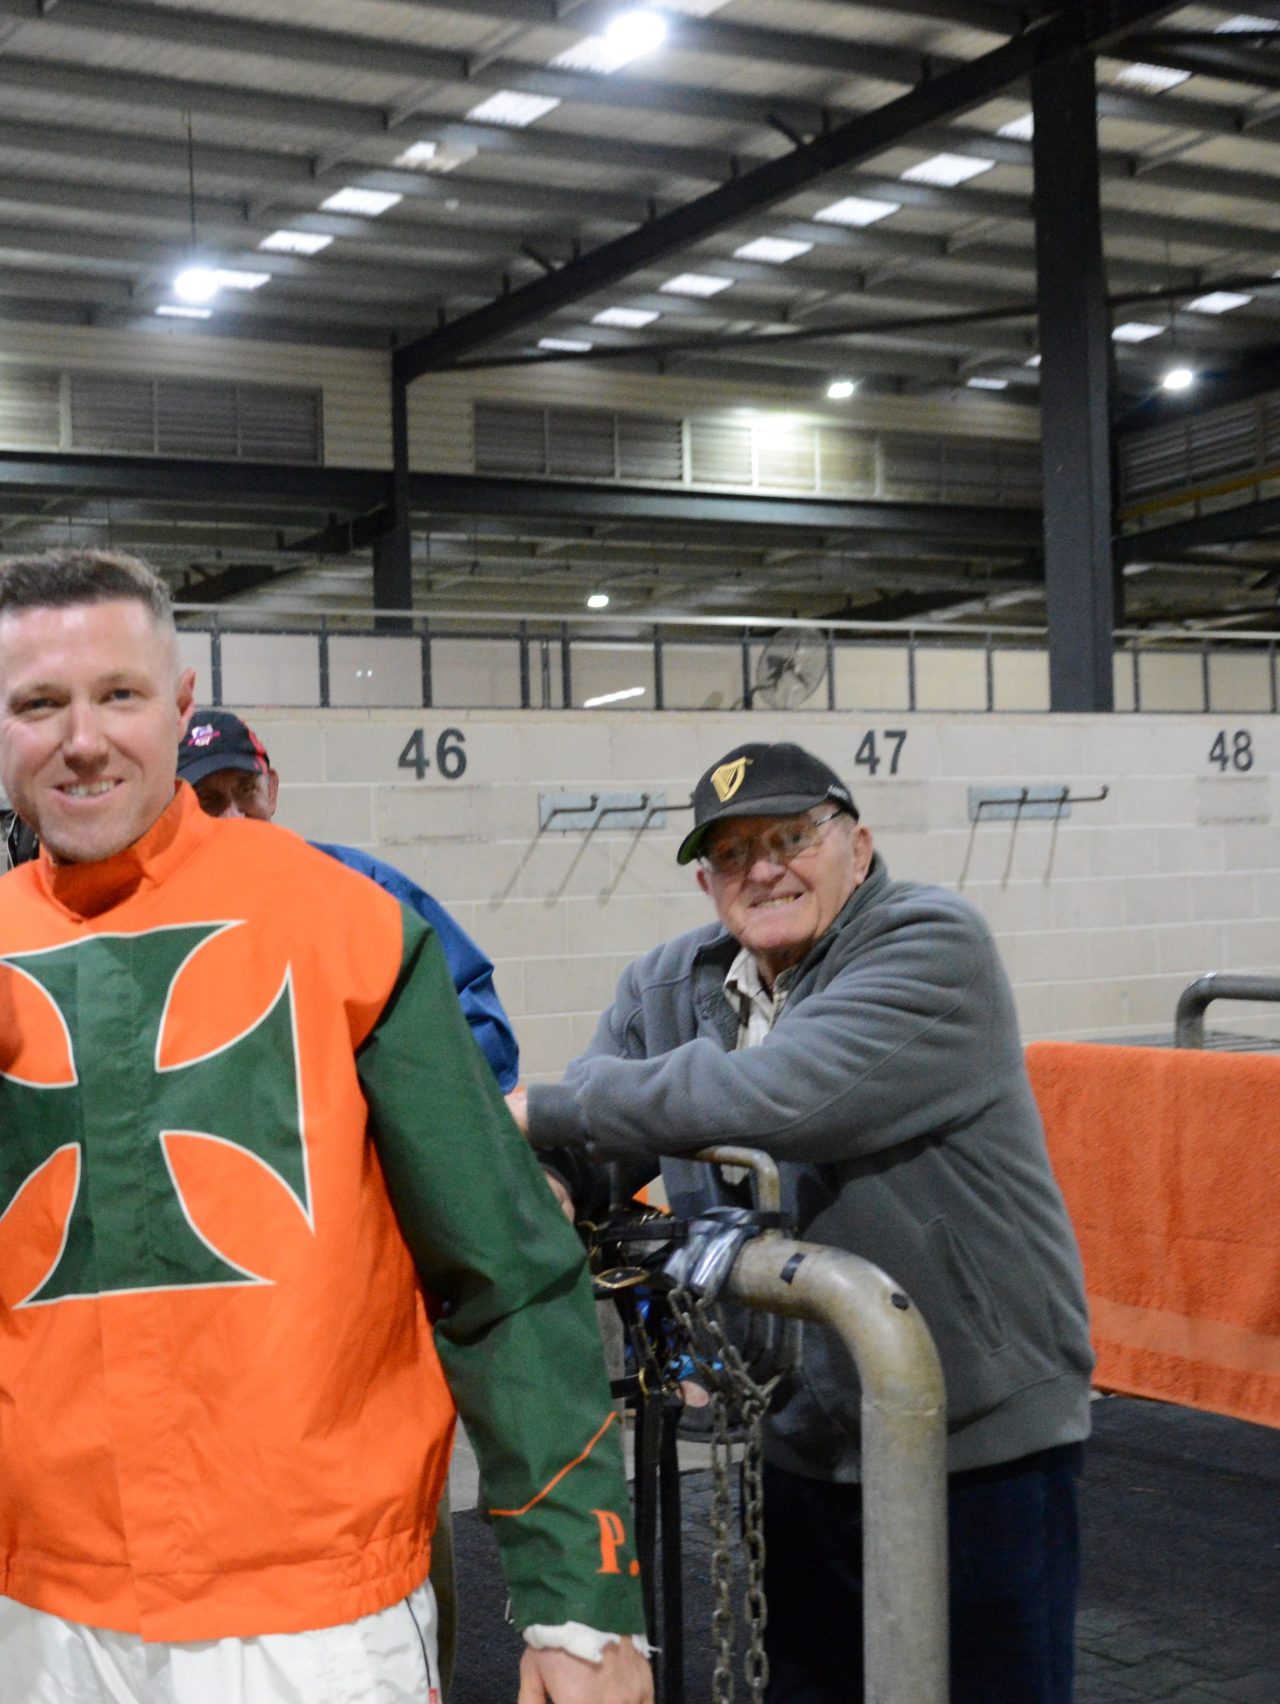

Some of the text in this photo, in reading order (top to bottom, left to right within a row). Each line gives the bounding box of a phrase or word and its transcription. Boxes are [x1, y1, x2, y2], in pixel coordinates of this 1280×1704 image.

[398, 728, 467, 780] 46
[854, 730, 907, 775] 47
[1209, 730, 1253, 772] 48
